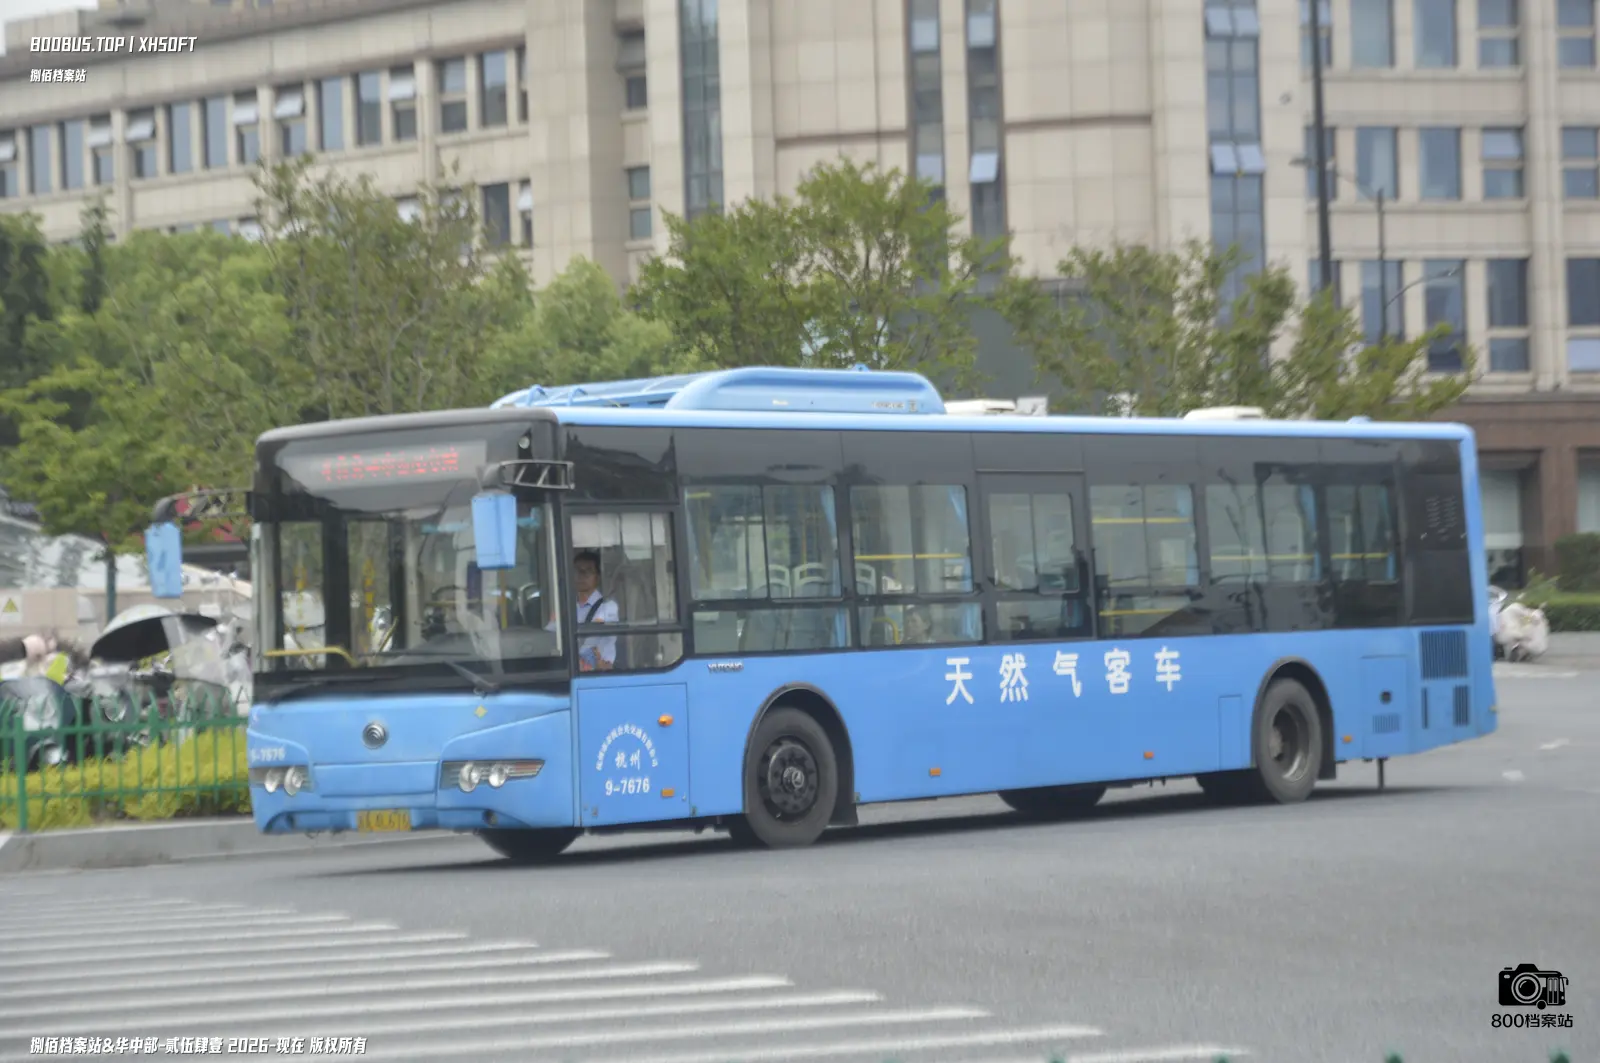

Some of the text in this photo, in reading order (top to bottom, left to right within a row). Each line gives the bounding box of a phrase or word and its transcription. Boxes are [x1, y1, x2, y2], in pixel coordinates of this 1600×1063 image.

[945, 646, 1182, 705] 天然气客车
[615, 749, 640, 770] 杭州
[604, 777, 651, 796] 9-7676
